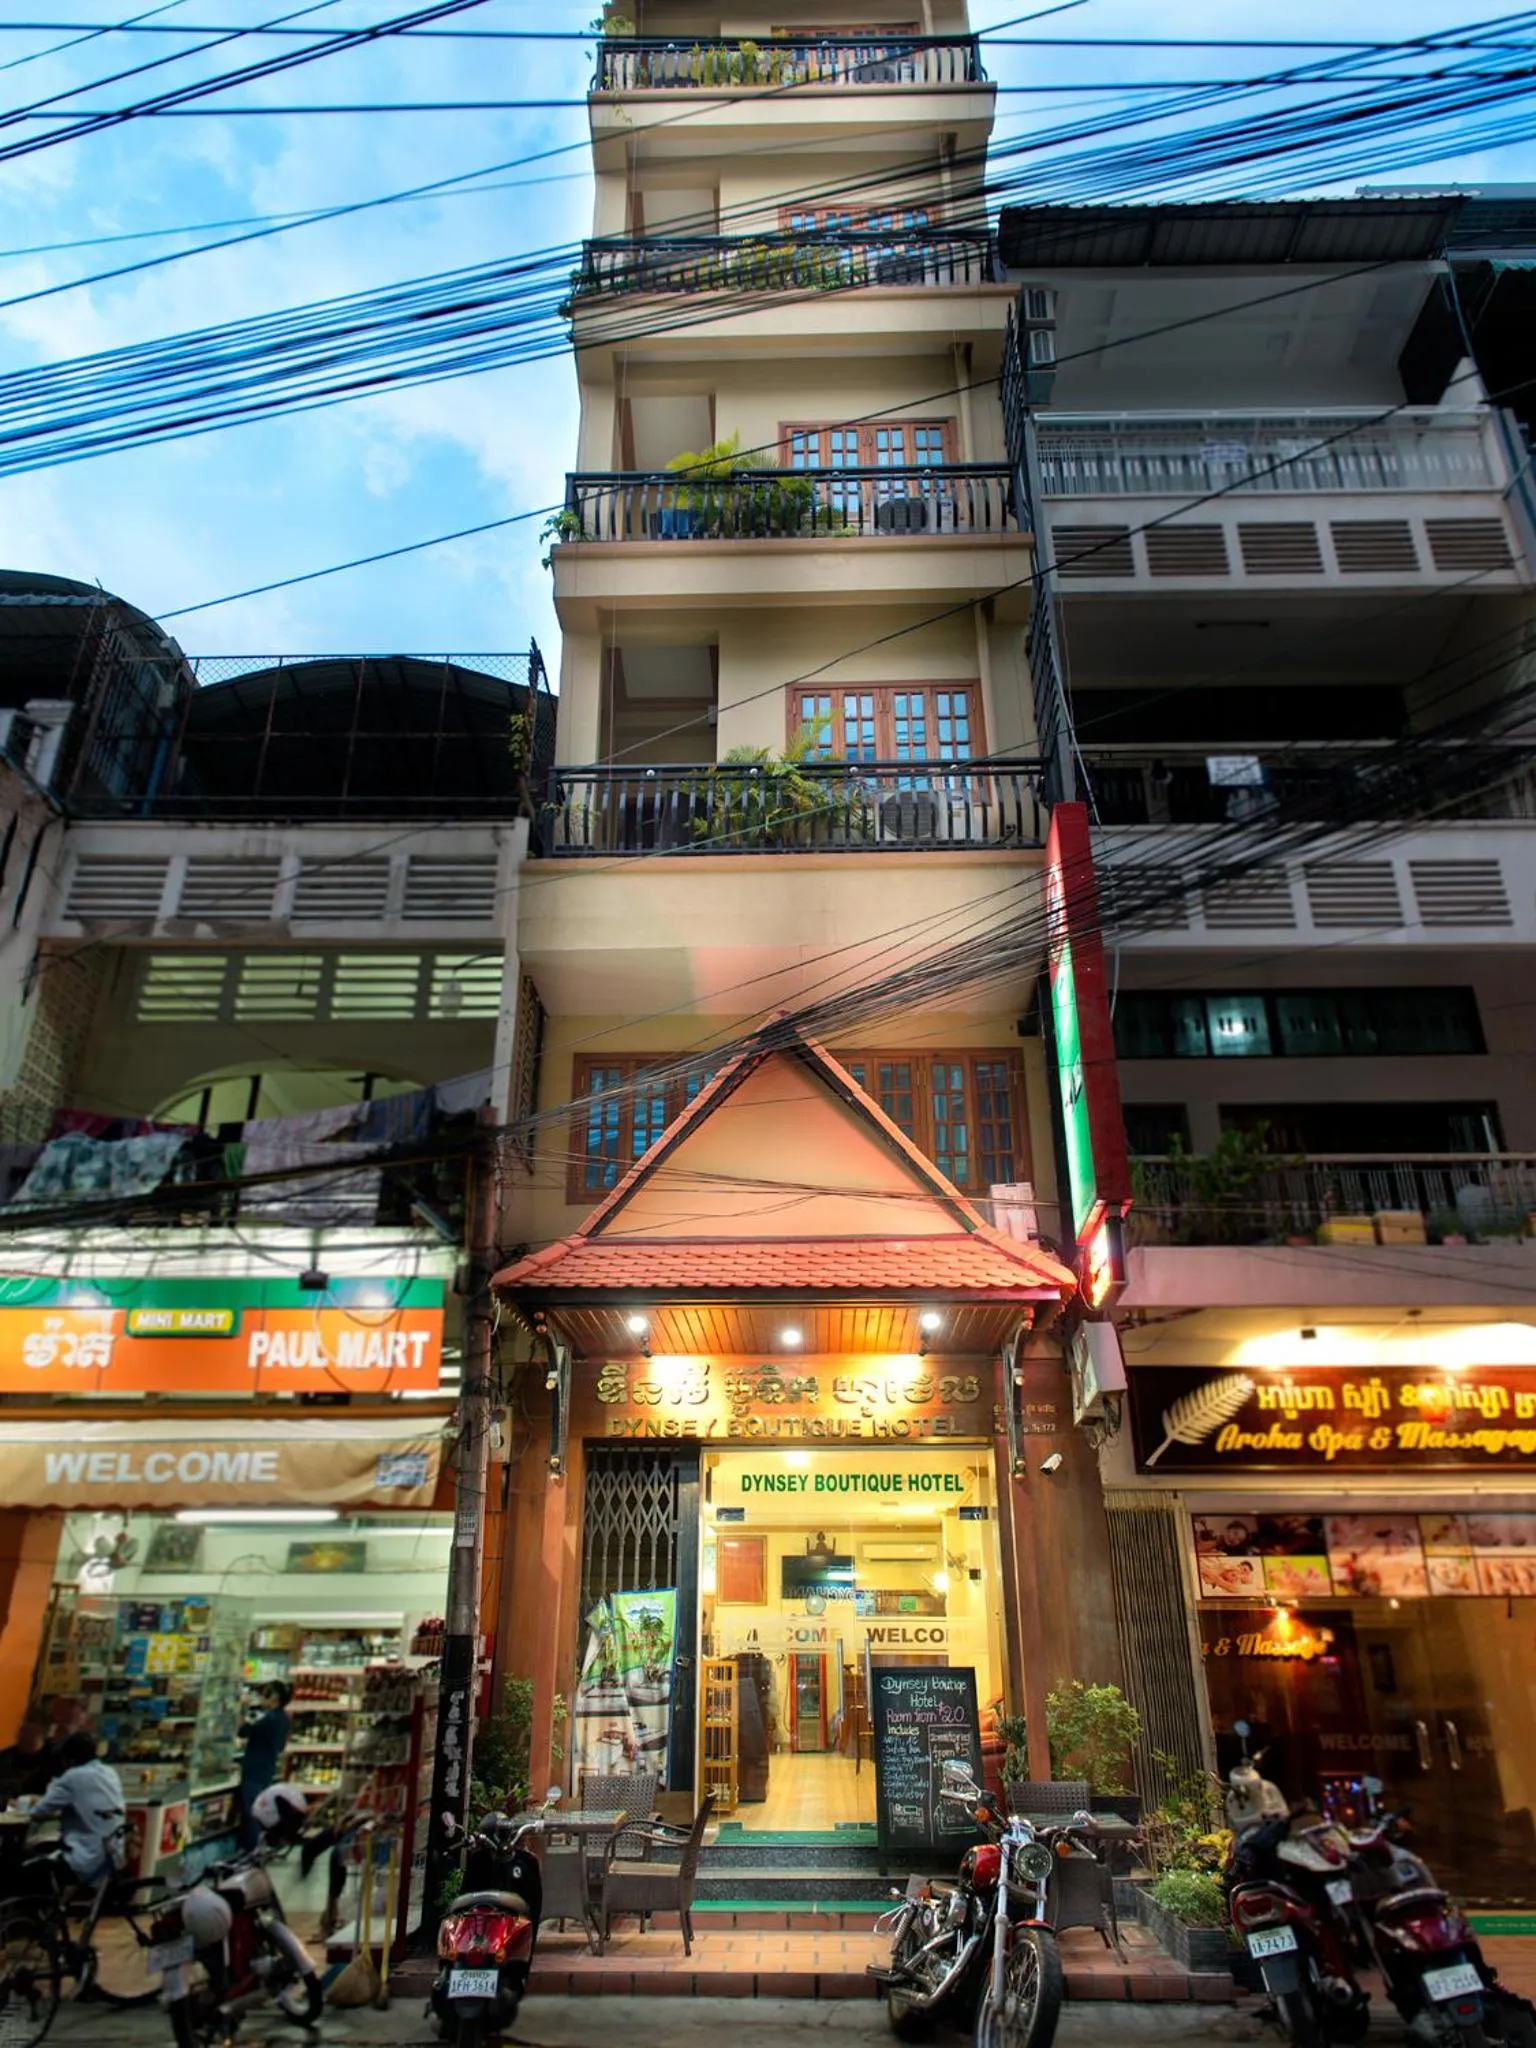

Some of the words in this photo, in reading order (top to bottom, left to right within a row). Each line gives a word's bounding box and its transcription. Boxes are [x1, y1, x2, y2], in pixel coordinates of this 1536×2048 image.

[137, 1313, 173, 1329] MINI
[179, 1313, 226, 1328] MART
[248, 1332, 327, 1368] PAUL
[336, 1332, 431, 1368] MART
[607, 1417, 719, 1437] DYNSEY
[727, 1416, 862, 1438] BOUTIQUE
[871, 1417, 966, 1436] HOTEL
[1308, 1424, 1364, 1460] Spa
[1368, 1427, 1392, 1449] &
[44, 1452, 280, 1484] WELCOME
[741, 1474, 809, 1492] DYNSEY
[815, 1474, 902, 1493] BOUTIQUE
[908, 1474, 964, 1492] HOTEL
[867, 1627, 949, 1643] WELCO
[880, 1676, 928, 1694] Dynsey
[910, 1693, 937, 1708] Hotel
[886, 1708, 912, 1725] Room
